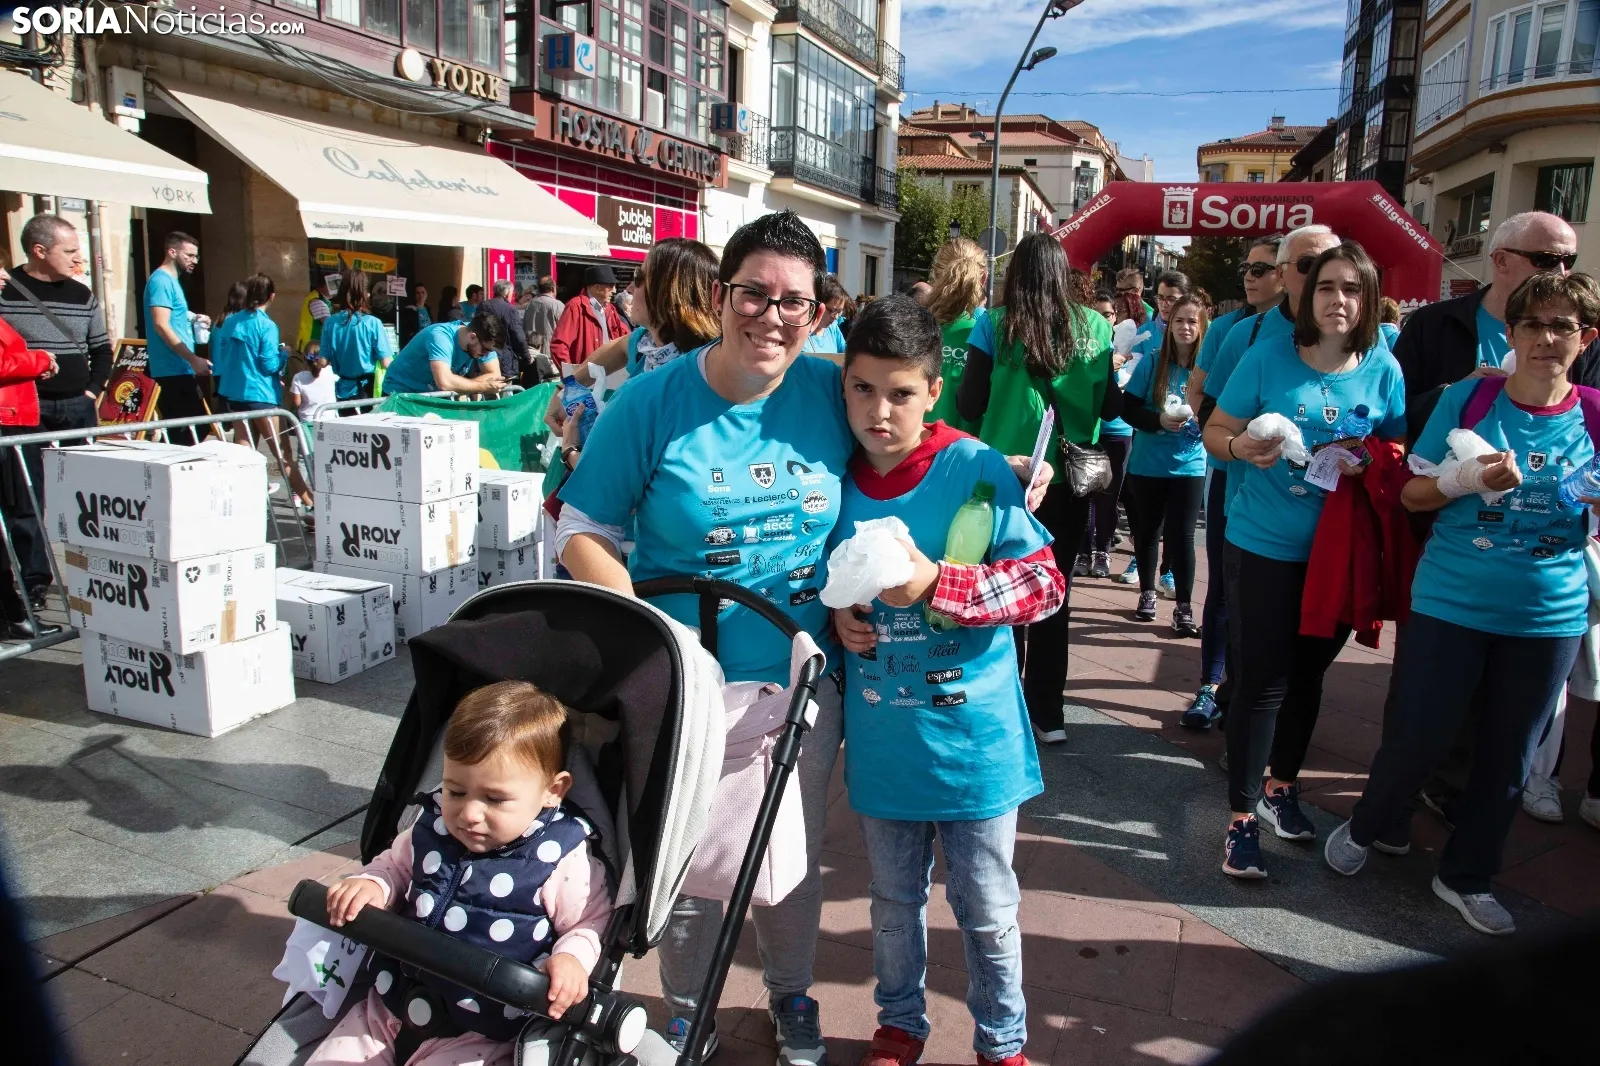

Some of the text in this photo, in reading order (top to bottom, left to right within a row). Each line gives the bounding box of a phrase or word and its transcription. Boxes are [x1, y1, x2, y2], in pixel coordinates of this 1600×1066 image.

[432, 58, 501, 100] YORK
[557, 103, 721, 178] HOSTAL CENTRO
[152, 185, 195, 204] YORK
[1232, 195, 1315, 203] AYUNTAMIENTO
[618, 205, 652, 228] bubble
[1199, 195, 1314, 230] Soria
[1372, 193, 1430, 250] #EligeSoria
[622, 227, 652, 245] waffle
[363, 261, 384, 271] ONCE
[330, 448, 369, 468] ROLY
[707, 485, 731, 493] Soria
[99, 494, 147, 521] ROLY
[361, 524, 401, 545] ROLY
[763, 521, 793, 531] aecc
[763, 529, 790, 537] soria
[86, 578, 127, 606] ROLY
[893, 620, 920, 629] aecc
[104, 664, 149, 692] ROLY
[927, 668, 962, 683] espora
